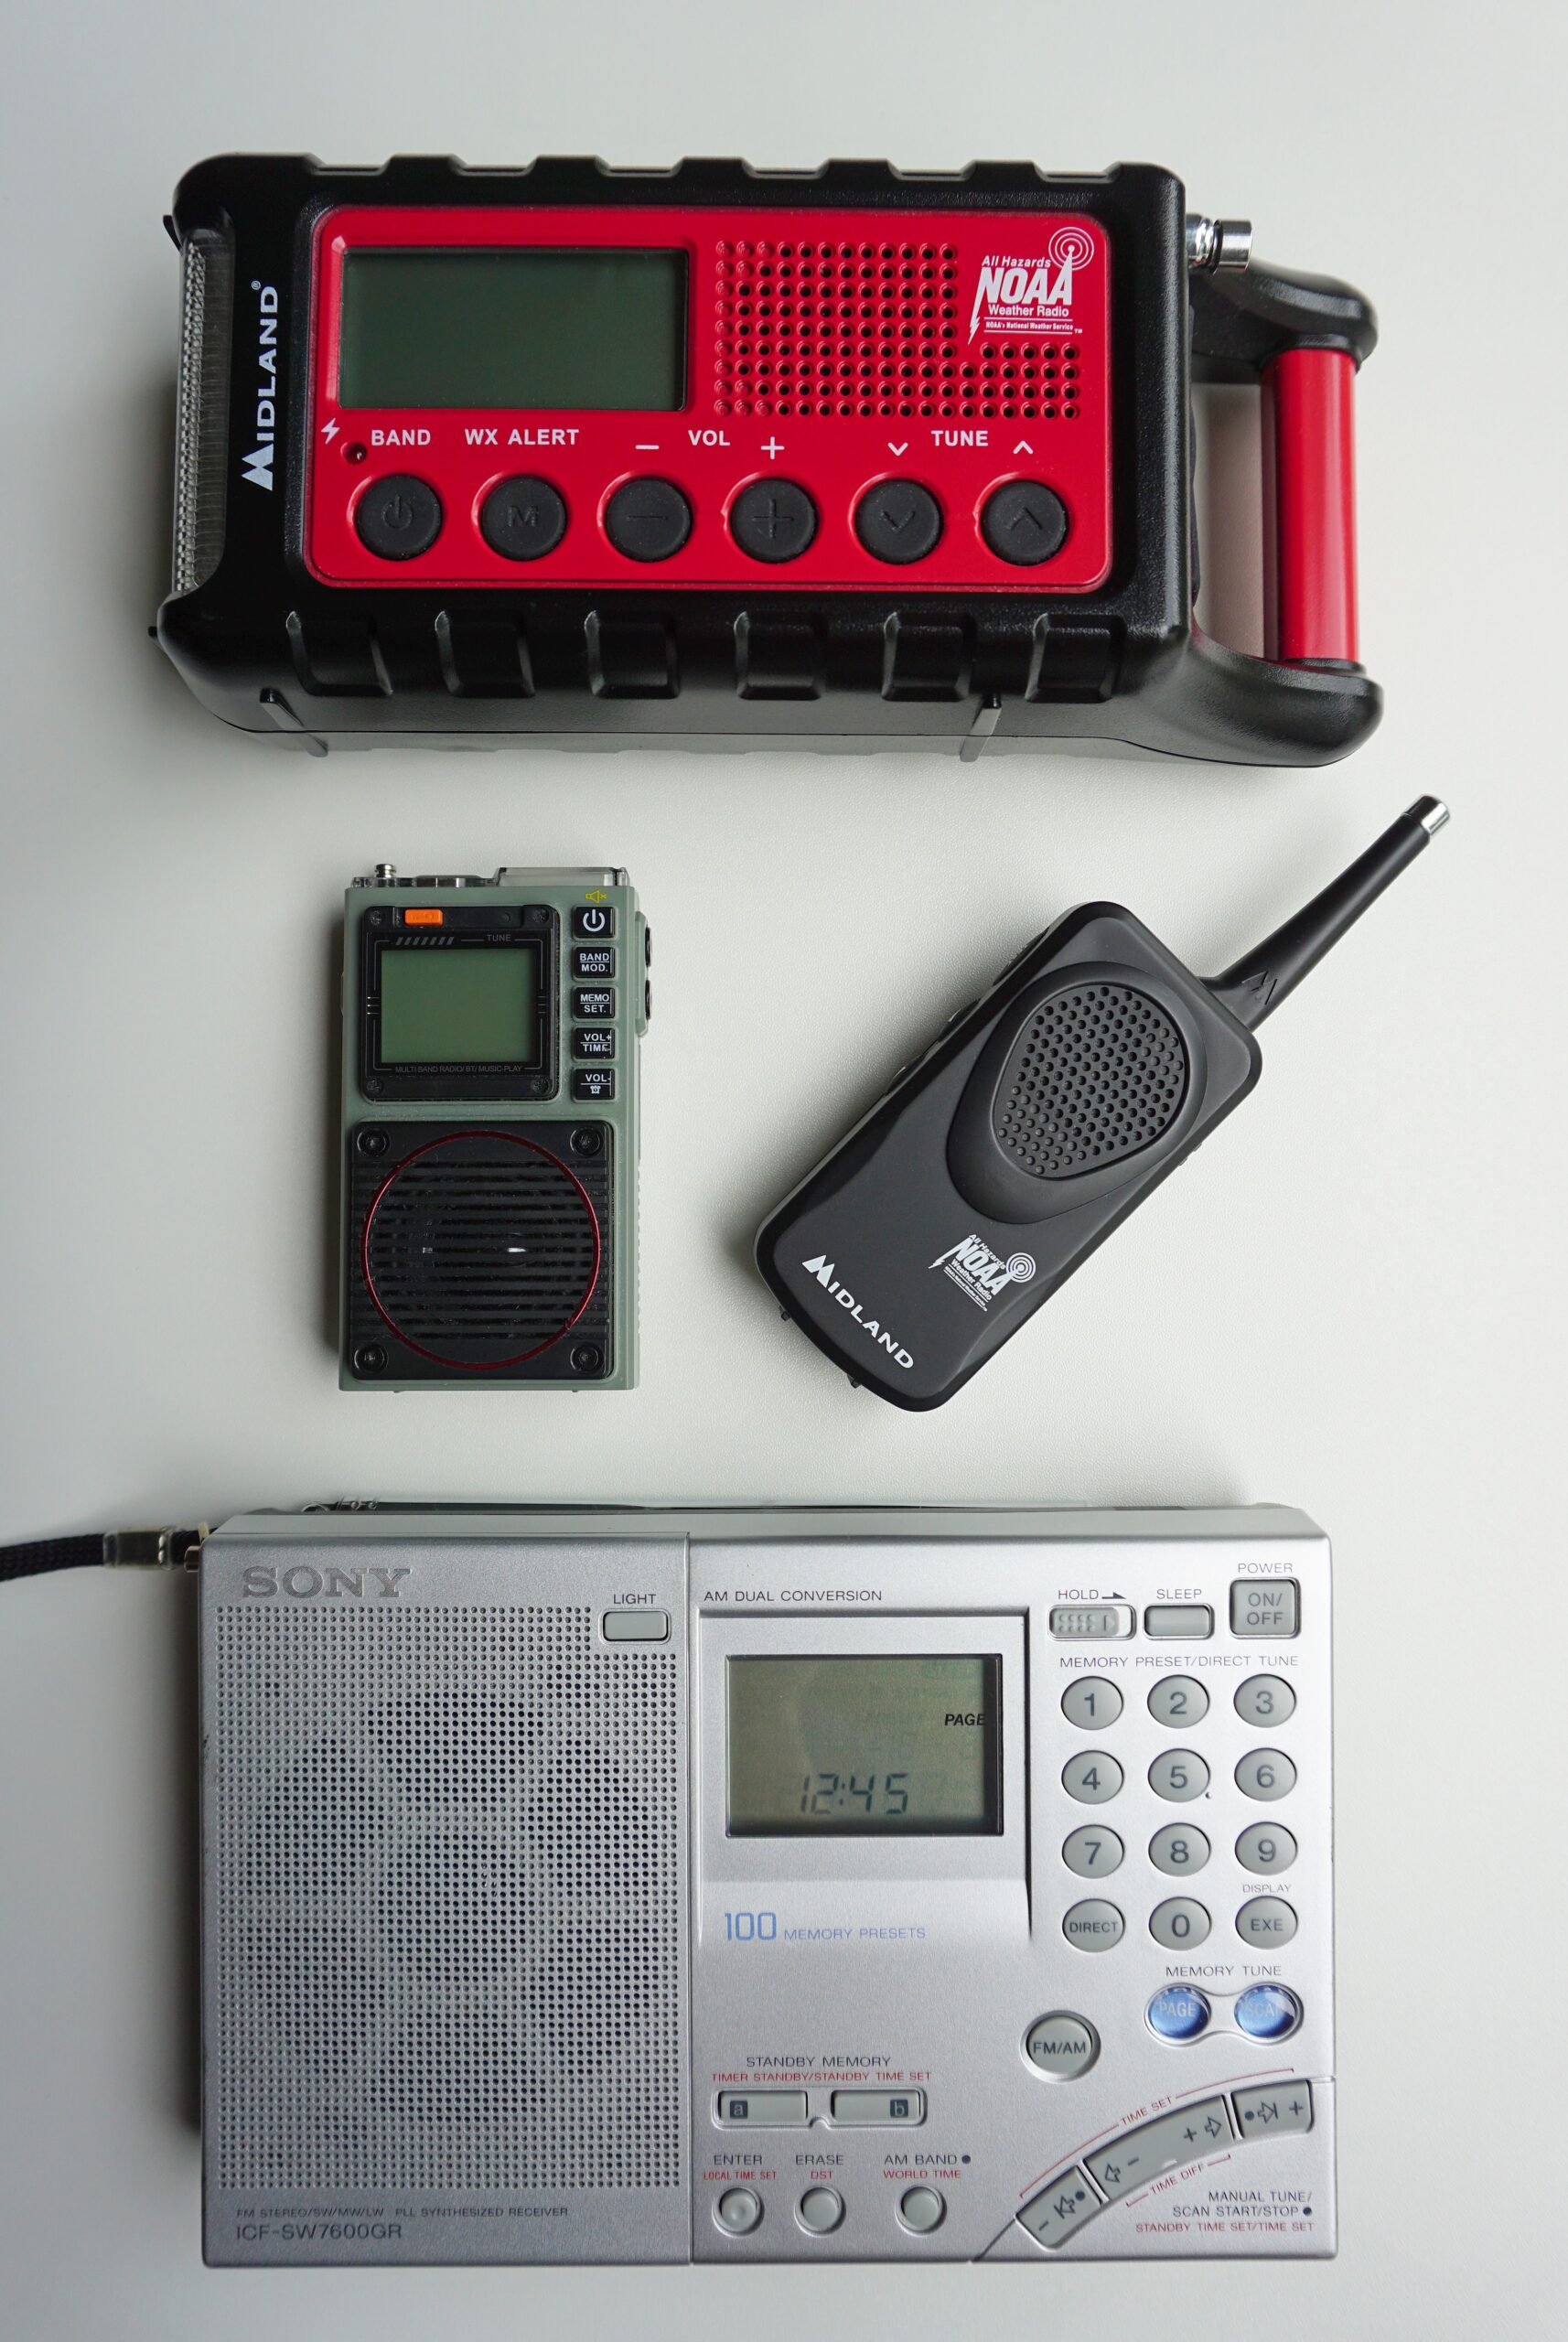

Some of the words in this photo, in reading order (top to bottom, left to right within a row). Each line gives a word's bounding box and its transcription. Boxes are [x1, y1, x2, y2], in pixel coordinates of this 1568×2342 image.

[982, 255, 999, 266] All
[1001, 256, 1051, 268] Hazards
[970, 263, 1073, 325] NOAA
[988, 305, 1034, 316] Weather
[1036, 306, 1069, 317] Radio
[1030, 322, 1052, 330] Weather
[1053, 323, 1074, 331] Service
[371, 429, 432, 446] BAND
[464, 429, 499, 446] WX
[507, 429, 580, 446] ALERT
[688, 429, 731, 446] VOL
[930, 430, 989, 446] TUNE
[508, 506, 539, 527] M
[487, 934, 512, 942] TUNE
[579, 952, 610, 962] BAND
[581, 963, 608, 972] MOD.
[580, 994, 610, 1003] MEMO
[584, 1004, 607, 1013] SET.
[969, 1233, 982, 1244] All
[979, 1242, 1006, 1270] Hazards
[940, 1237, 1014, 1295] NOAA
[950, 1258, 976, 1284] Weather
[973, 1281, 993, 1300] Radio
[801, 1254, 914, 1369] MIDLAND
[1238, 1563, 1293, 1574] POWER
[242, 1565, 411, 1597] SONY
[613, 1594, 657, 1605] LIGHT
[703, 1590, 728, 1602] AM
[735, 1590, 774, 1602] DUAL
[780, 1590, 882, 1601] CONVERSION
[1058, 1589, 1099, 1600] HOLD
[1156, 1588, 1202, 1599] SLEEP
[1247, 1593, 1283, 1607] ON/
[1246, 1612, 1283, 1626] OFF
[1060, 1657, 1129, 1668] MEMORY
[1135, 1656, 1251, 1667] PRESET/DIRECT
[1259, 1656, 1299, 1666] TUNE
[1084, 1692, 1095, 1716] 1
[1169, 1691, 1187, 1715] 2
[1255, 1691, 1274, 1714] 3
[944, 1714, 986, 1726] PAGE
[1081, 1767, 1101, 1790] 4
[1169, 1766, 1188, 1789] 5
[1256, 1764, 1275, 1788] 6
[800, 1773, 908, 1815] 12:45
[1084, 1842, 1101, 1865] 7
[1170, 1840, 1189, 1864] 8
[1257, 1839, 1276, 1863] 9
[1242, 1885, 1292, 1894] DISPLAY
[725, 1911, 777, 1941] 100
[784, 1928, 852, 1940] MEMORY
[859, 1927, 926, 1939] PRESETS
[1069, 1921, 1118, 1933] DIRECT
[1171, 1914, 1190, 1938] 0
[1251, 1918, 1283, 1931] EXE
[1165, 1966, 1235, 1977] MEMORY
[1242, 1965, 1282, 1976] TUNE
[1159, 2002, 1197, 2017] PAGE
[1033, 2041, 1086, 2055] FM/AM
[746, 2057, 815, 2068] STANDBY
[822, 2057, 891, 2068] MEMORY
[712, 2073, 748, 2082] TIMER
[753, 2072, 869, 2082] STANDBY/STANDBY
[875, 2072, 904, 2081] TIME
[909, 2071, 931, 2080] SET
[1121, 2108, 1149, 2126] TIME
[1151, 2096, 1174, 2112] SET
[714, 2154, 763, 2165] ENTER
[796, 2154, 844, 2165] ERASE
[884, 2155, 908, 2165] AM
[915, 2154, 958, 2165] BAND
[703, 2170, 732, 2180] LOCAL
[735, 2170, 757, 2180] TIME
[760, 2170, 777, 2180] SET
[811, 2170, 834, 2179] DST
[883, 2169, 929, 2179] WORLD
[932, 2169, 961, 2179] TIME
[1149, 2176, 1178, 2195] TIME
[1179, 2164, 1207, 2180] DIFF
[1208, 2192, 1266, 2202] MANUAL
[1270, 2191, 1312, 2202] TUNE/
[236, 2208, 255, 2218] FM
[395, 2208, 417, 2217] PLL
[421, 2208, 503, 2218] SYNTHESIZED
[509, 2208, 568, 2217] RECEIVER
[1173, 2207, 1210, 2217] SCAN
[1216, 2206, 1299, 2217] START/STOP
[237, 2223, 403, 2240] ICF-SW7600GR
[1135, 2223, 1190, 2233] STANDBY
[1197, 2223, 1226, 2233] TIME
[1230, 2222, 1287, 2233] SET/TIME
[1291, 2222, 1315, 2232] SET
